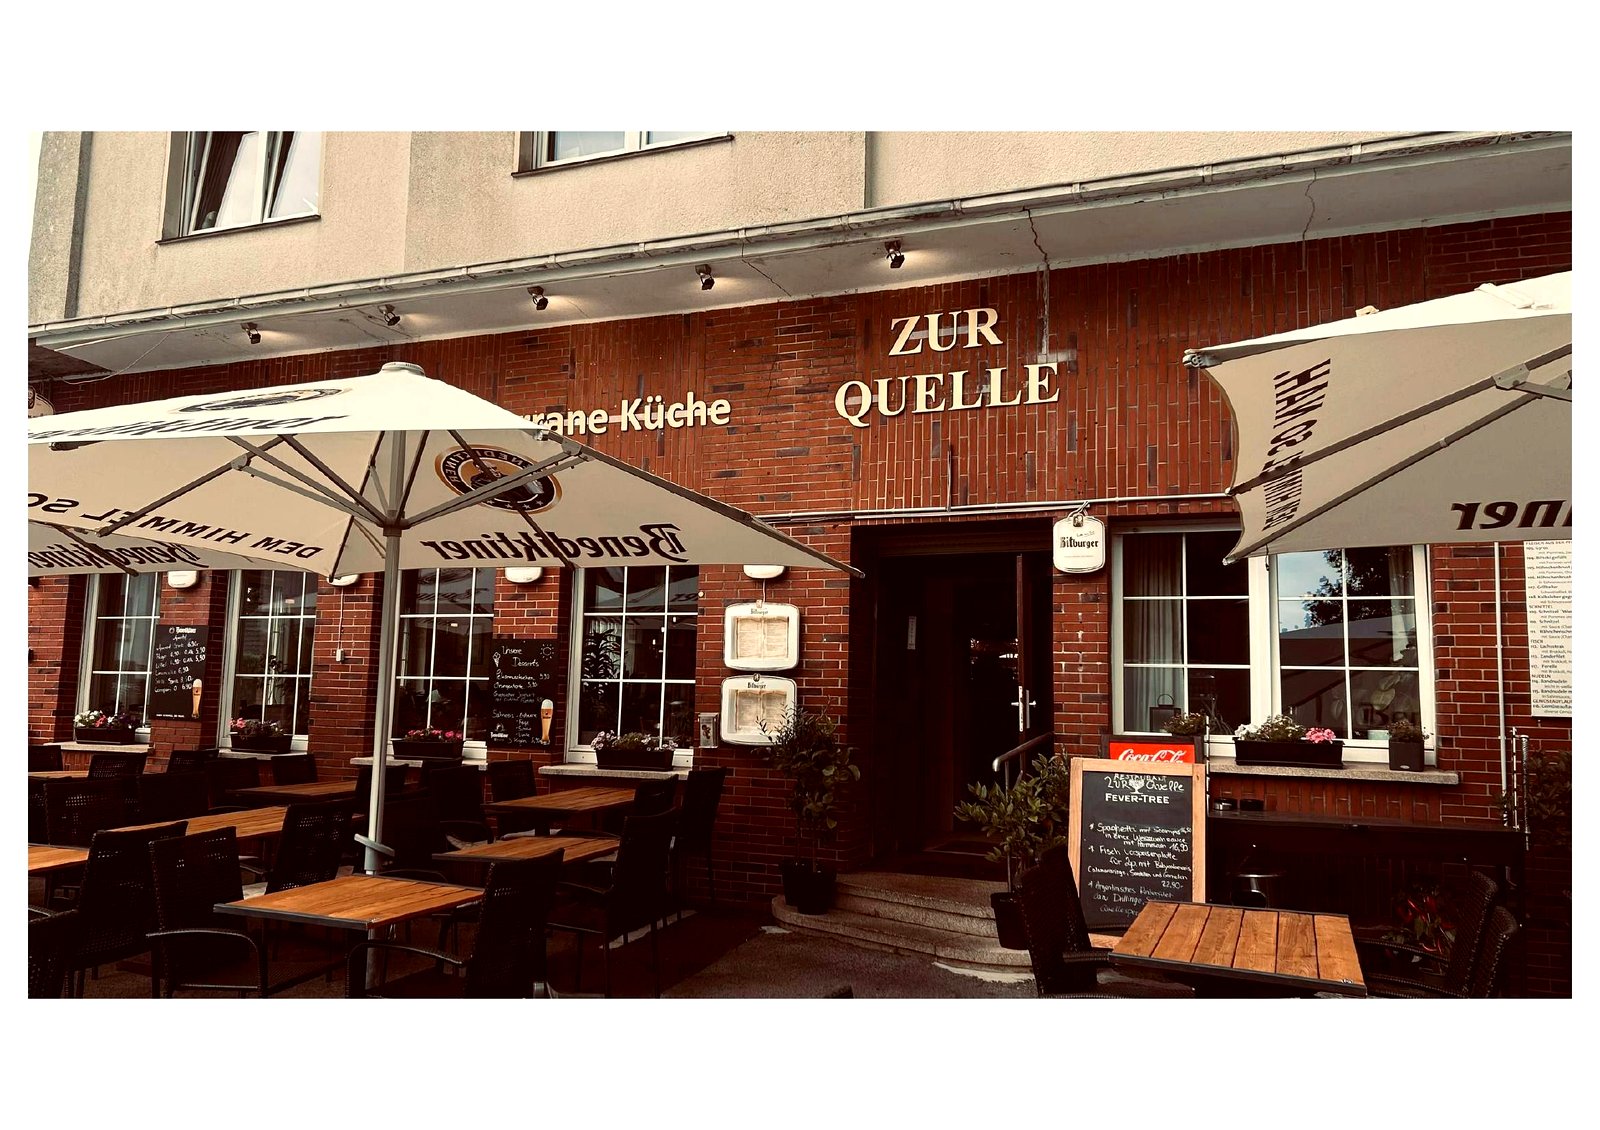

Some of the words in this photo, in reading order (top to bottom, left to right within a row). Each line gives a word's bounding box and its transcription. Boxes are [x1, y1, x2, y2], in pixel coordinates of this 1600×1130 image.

[888, 307, 1004, 357] ZUR
[834, 362, 1060, 428] QUELLE
[521, 408, 610, 437] rane
[620, 391, 732, 433] Küche
[1060, 536, 1099, 549] Bitburger
[1145, 780, 1185, 792] Quelle
[1105, 792, 1170, 804] FEVER-TREE
[1097, 822, 1136, 834] Spaghetti
[1099, 845, 1121, 855] Fisch
[1109, 856, 1122, 865] für
